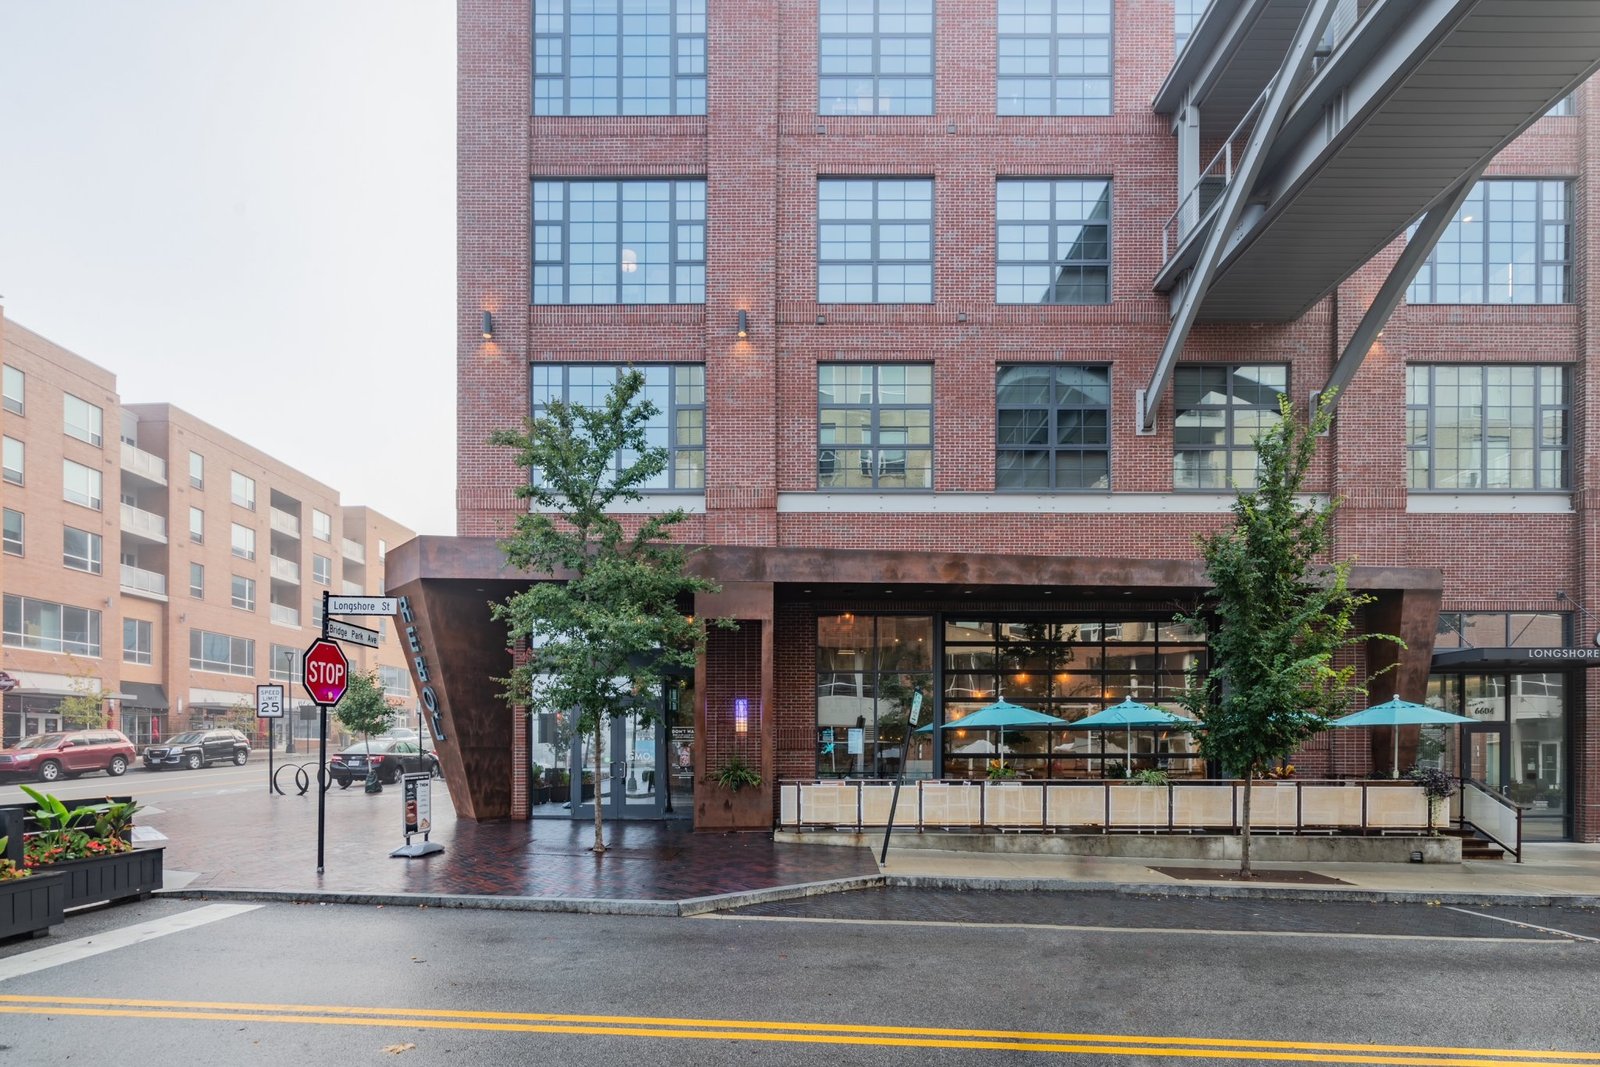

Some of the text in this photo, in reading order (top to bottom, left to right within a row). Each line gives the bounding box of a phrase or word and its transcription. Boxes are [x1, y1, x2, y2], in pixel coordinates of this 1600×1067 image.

[333, 601, 390, 613] Longshore St
[329, 624, 377, 644] Bridge Park Ave
[1528, 649, 1600, 658] LONGSHORE
[308, 660, 344, 685] STOP
[261, 702, 280, 713] 25
